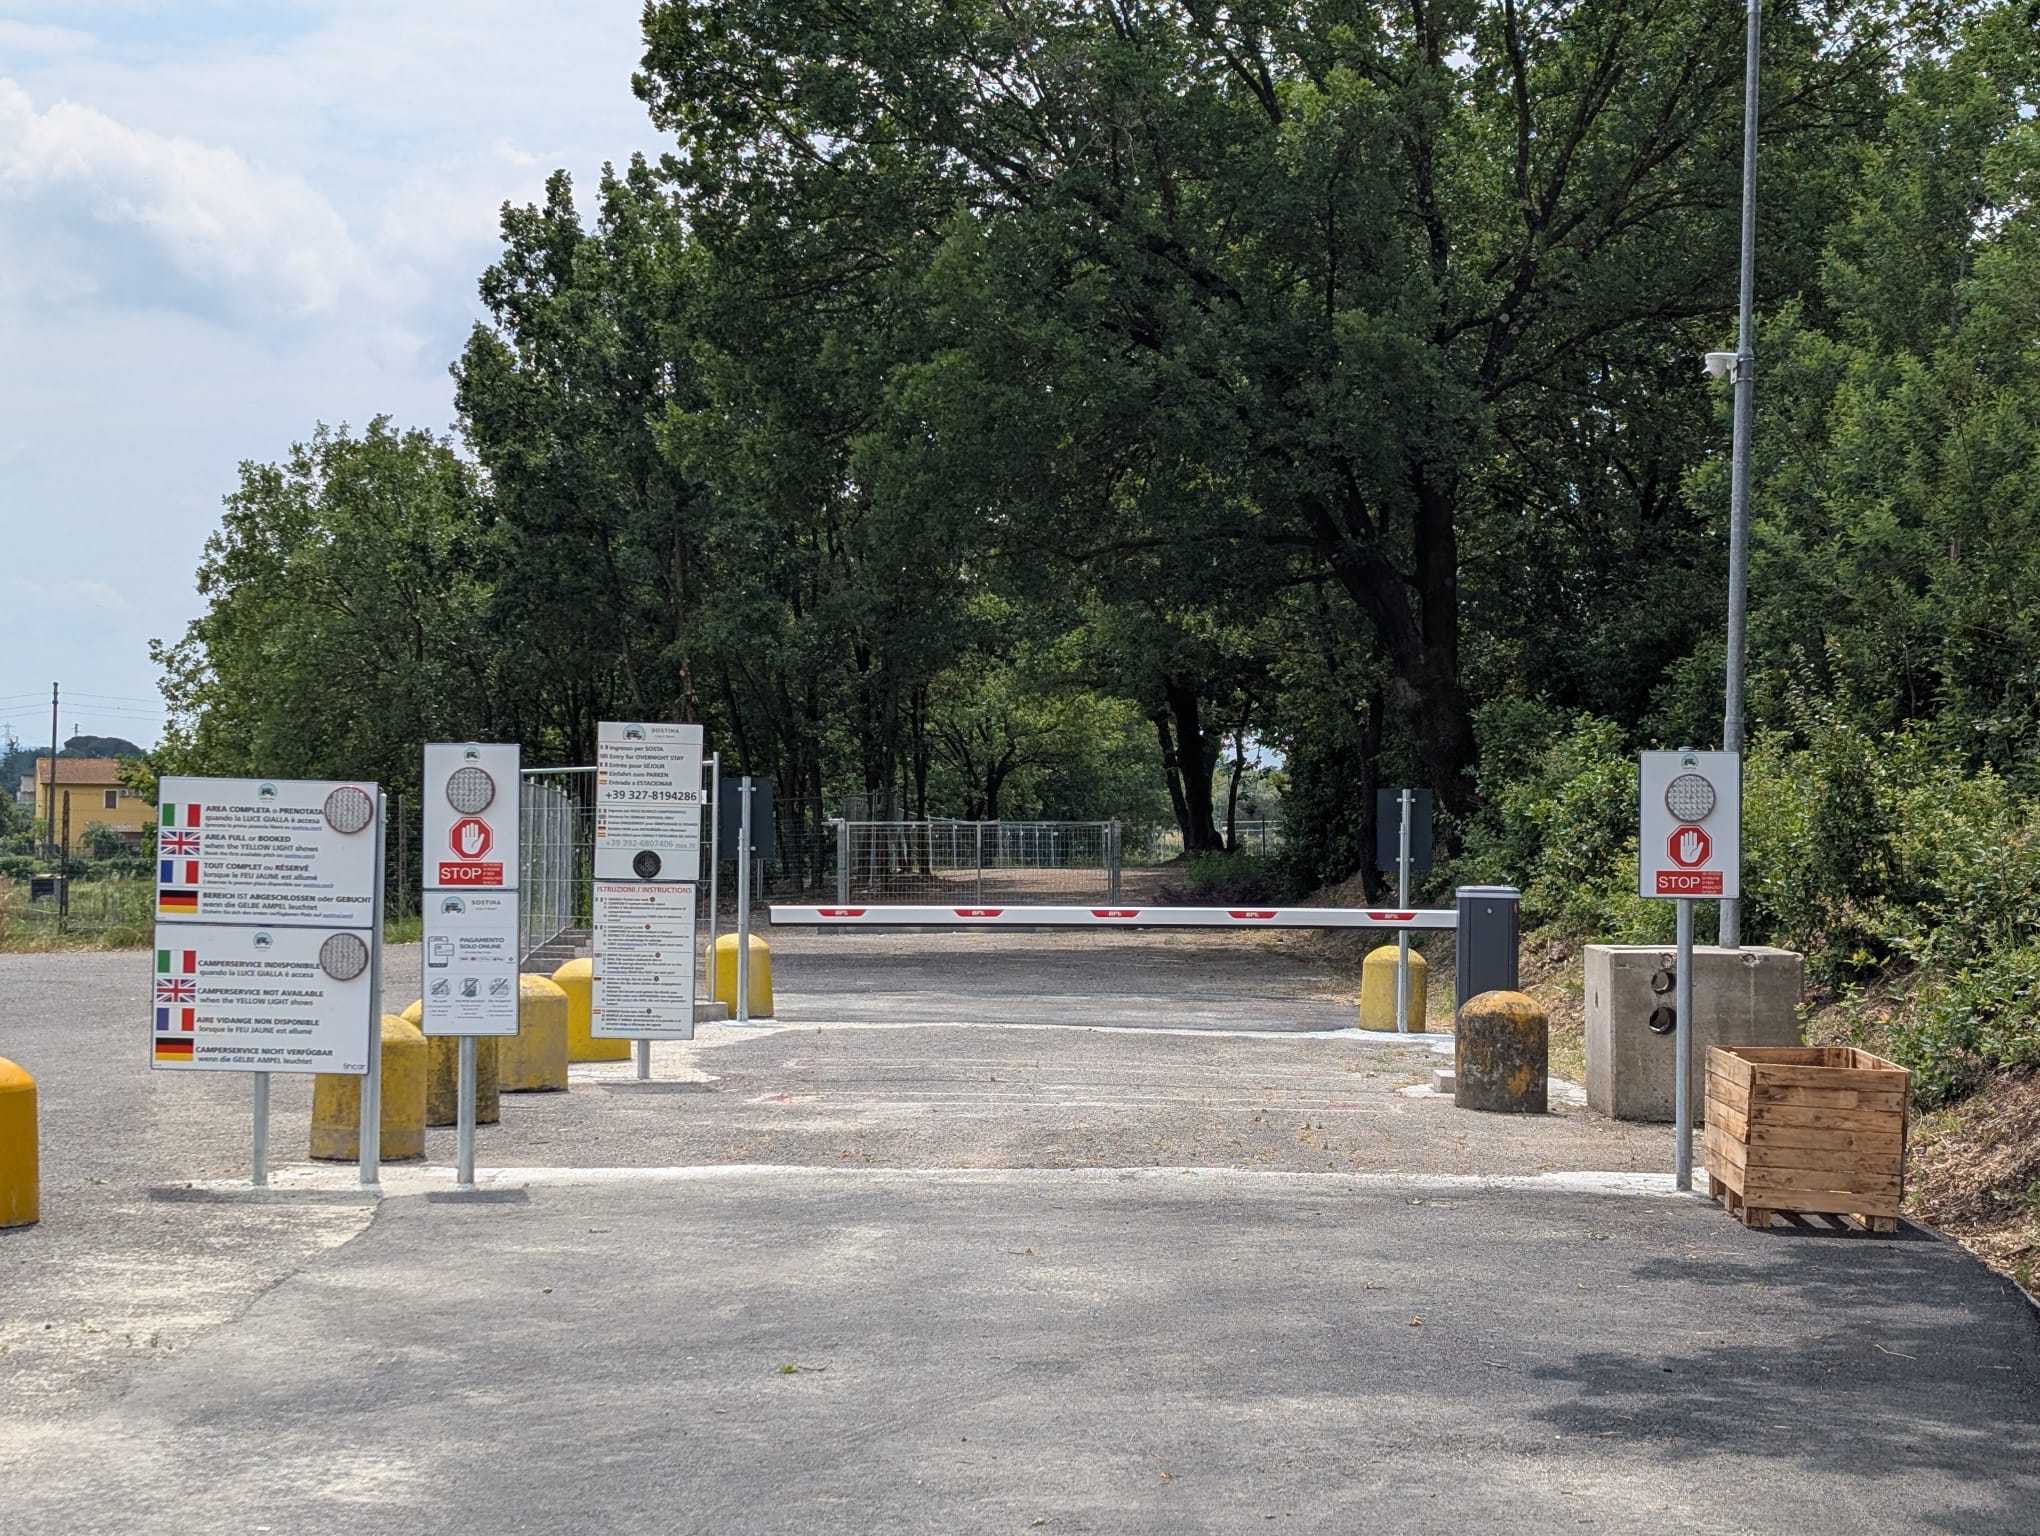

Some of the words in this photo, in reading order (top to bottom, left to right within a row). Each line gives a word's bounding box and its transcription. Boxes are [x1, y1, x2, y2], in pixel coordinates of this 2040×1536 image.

[606, 790, 625, 799] +39
[629, 790, 697, 800] 327-8194286
[441, 868, 481, 880] STOP
[1658, 876, 1700, 888] STOP
[250, 894, 315, 902] ABGESCHLOSSEN
[287, 1047, 333, 1056] VERFÜGBAR
